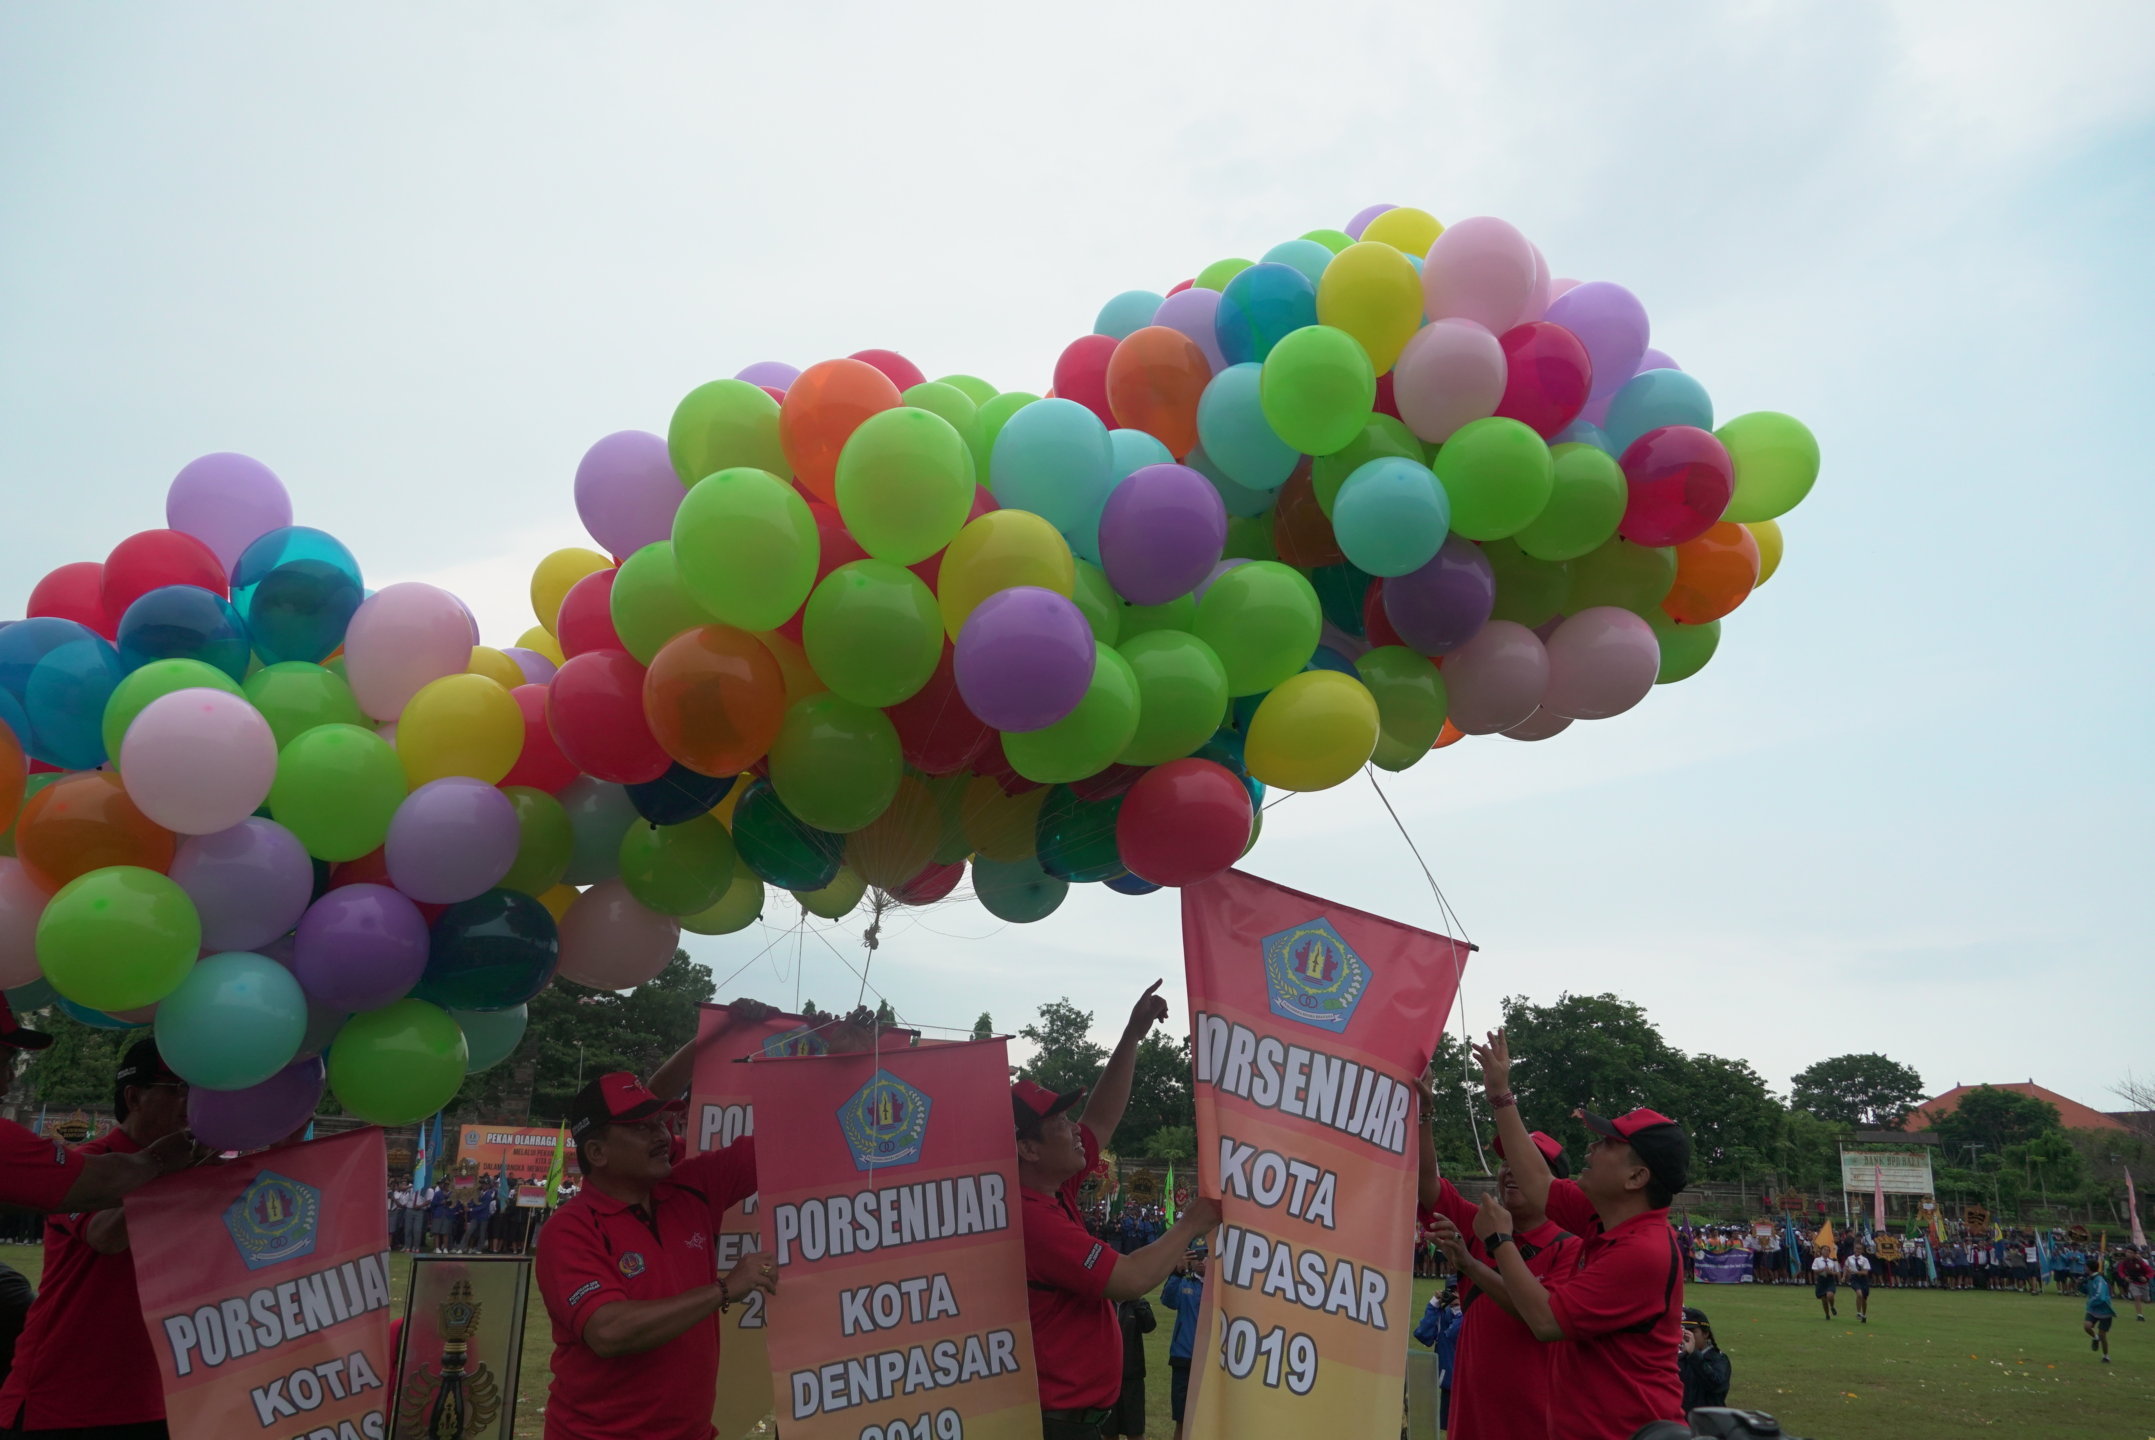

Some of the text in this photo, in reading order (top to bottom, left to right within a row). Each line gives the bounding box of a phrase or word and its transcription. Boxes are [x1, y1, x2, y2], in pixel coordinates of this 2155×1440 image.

[487, 1133, 513, 1145] PEKAN
[514, 1134, 557, 1147] OLAHRAGA
[1220, 1136, 1338, 1230] KOTA
[774, 1173, 1009, 1267] PORSENIJAR
[163, 1251, 389, 1377] PORSENIJA
[839, 1273, 960, 1336] KOTA
[250, 1351, 384, 1427] KOTA
[792, 1329, 1020, 1420] DENPASAR
